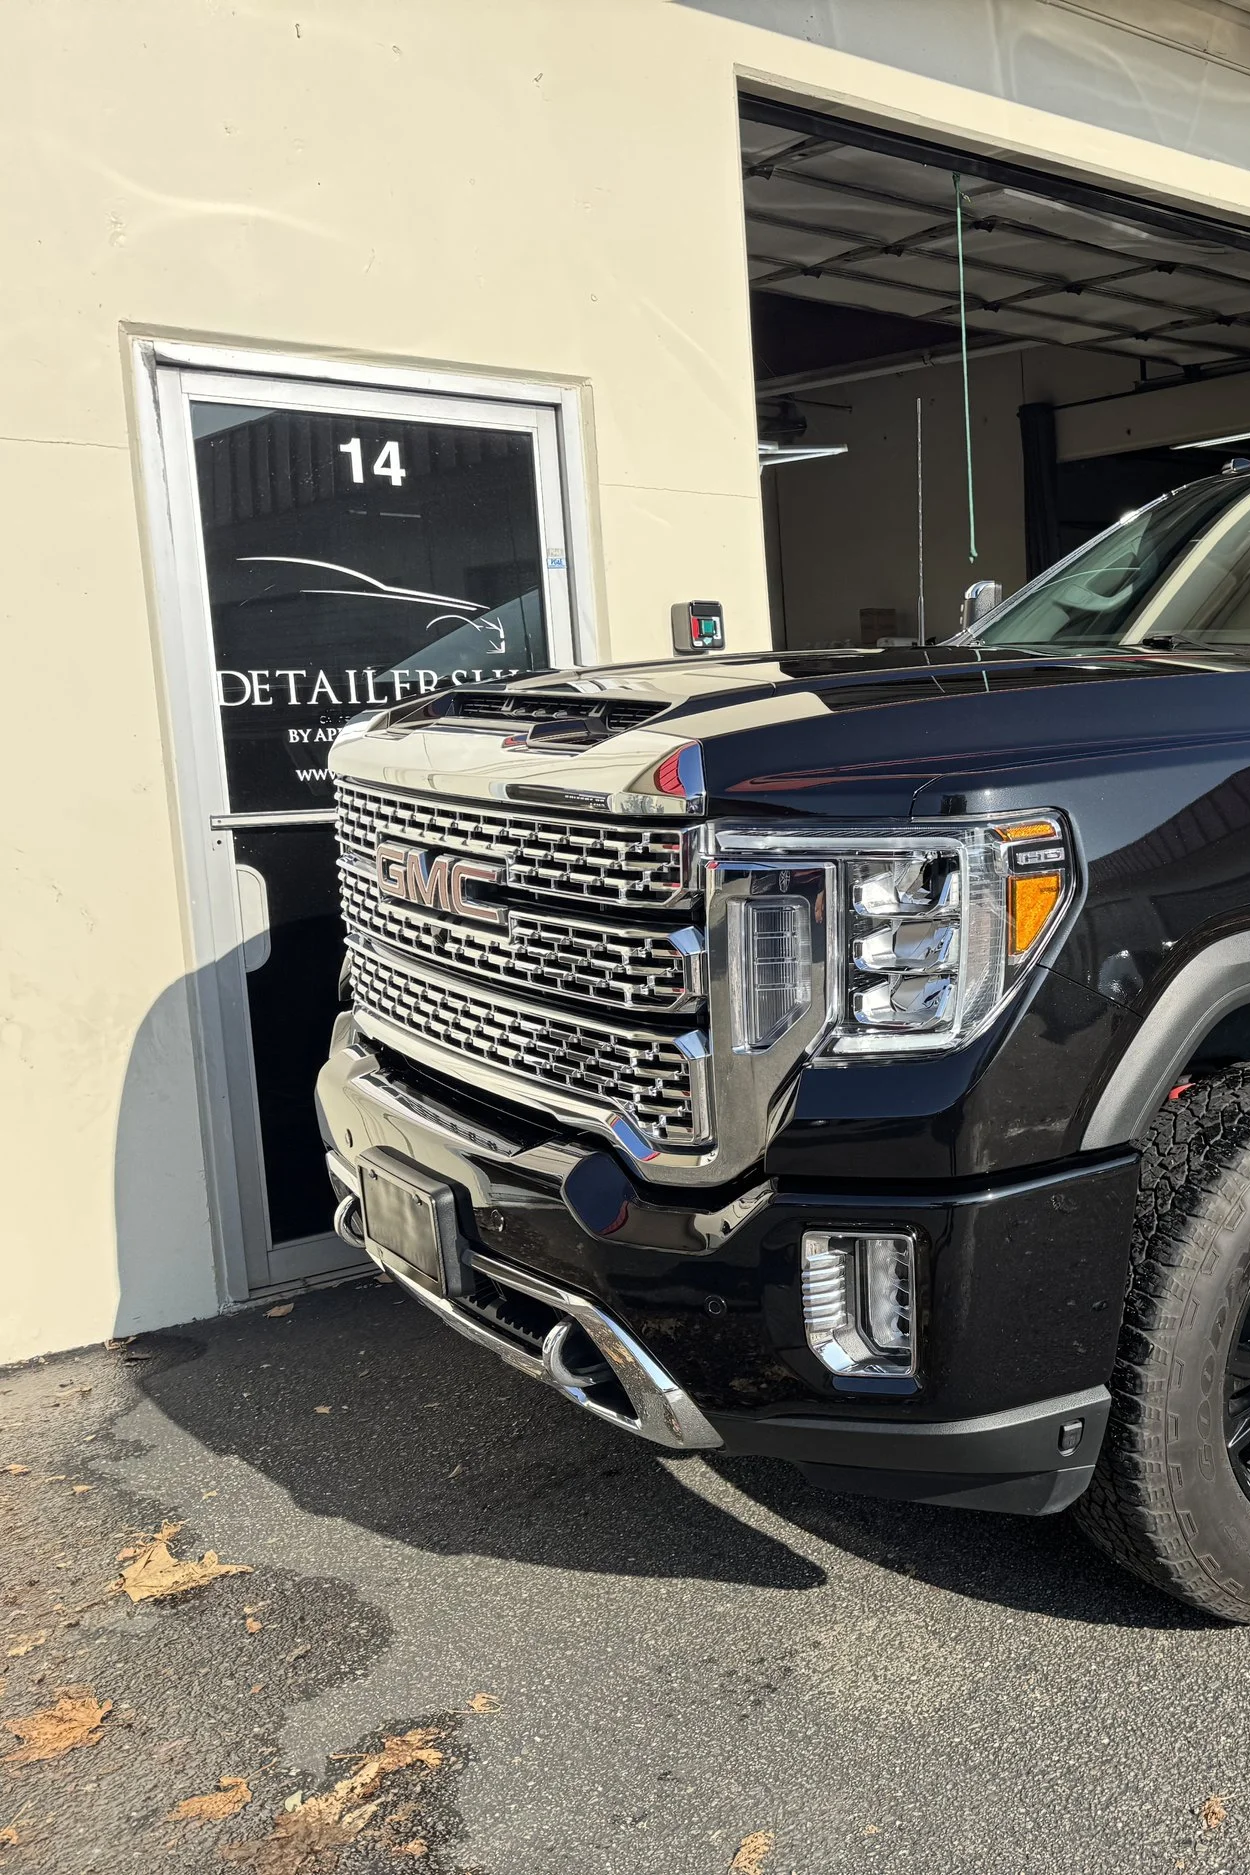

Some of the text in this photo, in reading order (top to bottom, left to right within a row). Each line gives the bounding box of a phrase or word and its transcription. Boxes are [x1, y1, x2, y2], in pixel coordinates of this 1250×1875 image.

[339, 437, 407, 486] 14
[288, 727, 342, 743] BY AP
[376, 842, 503, 925] GMC
